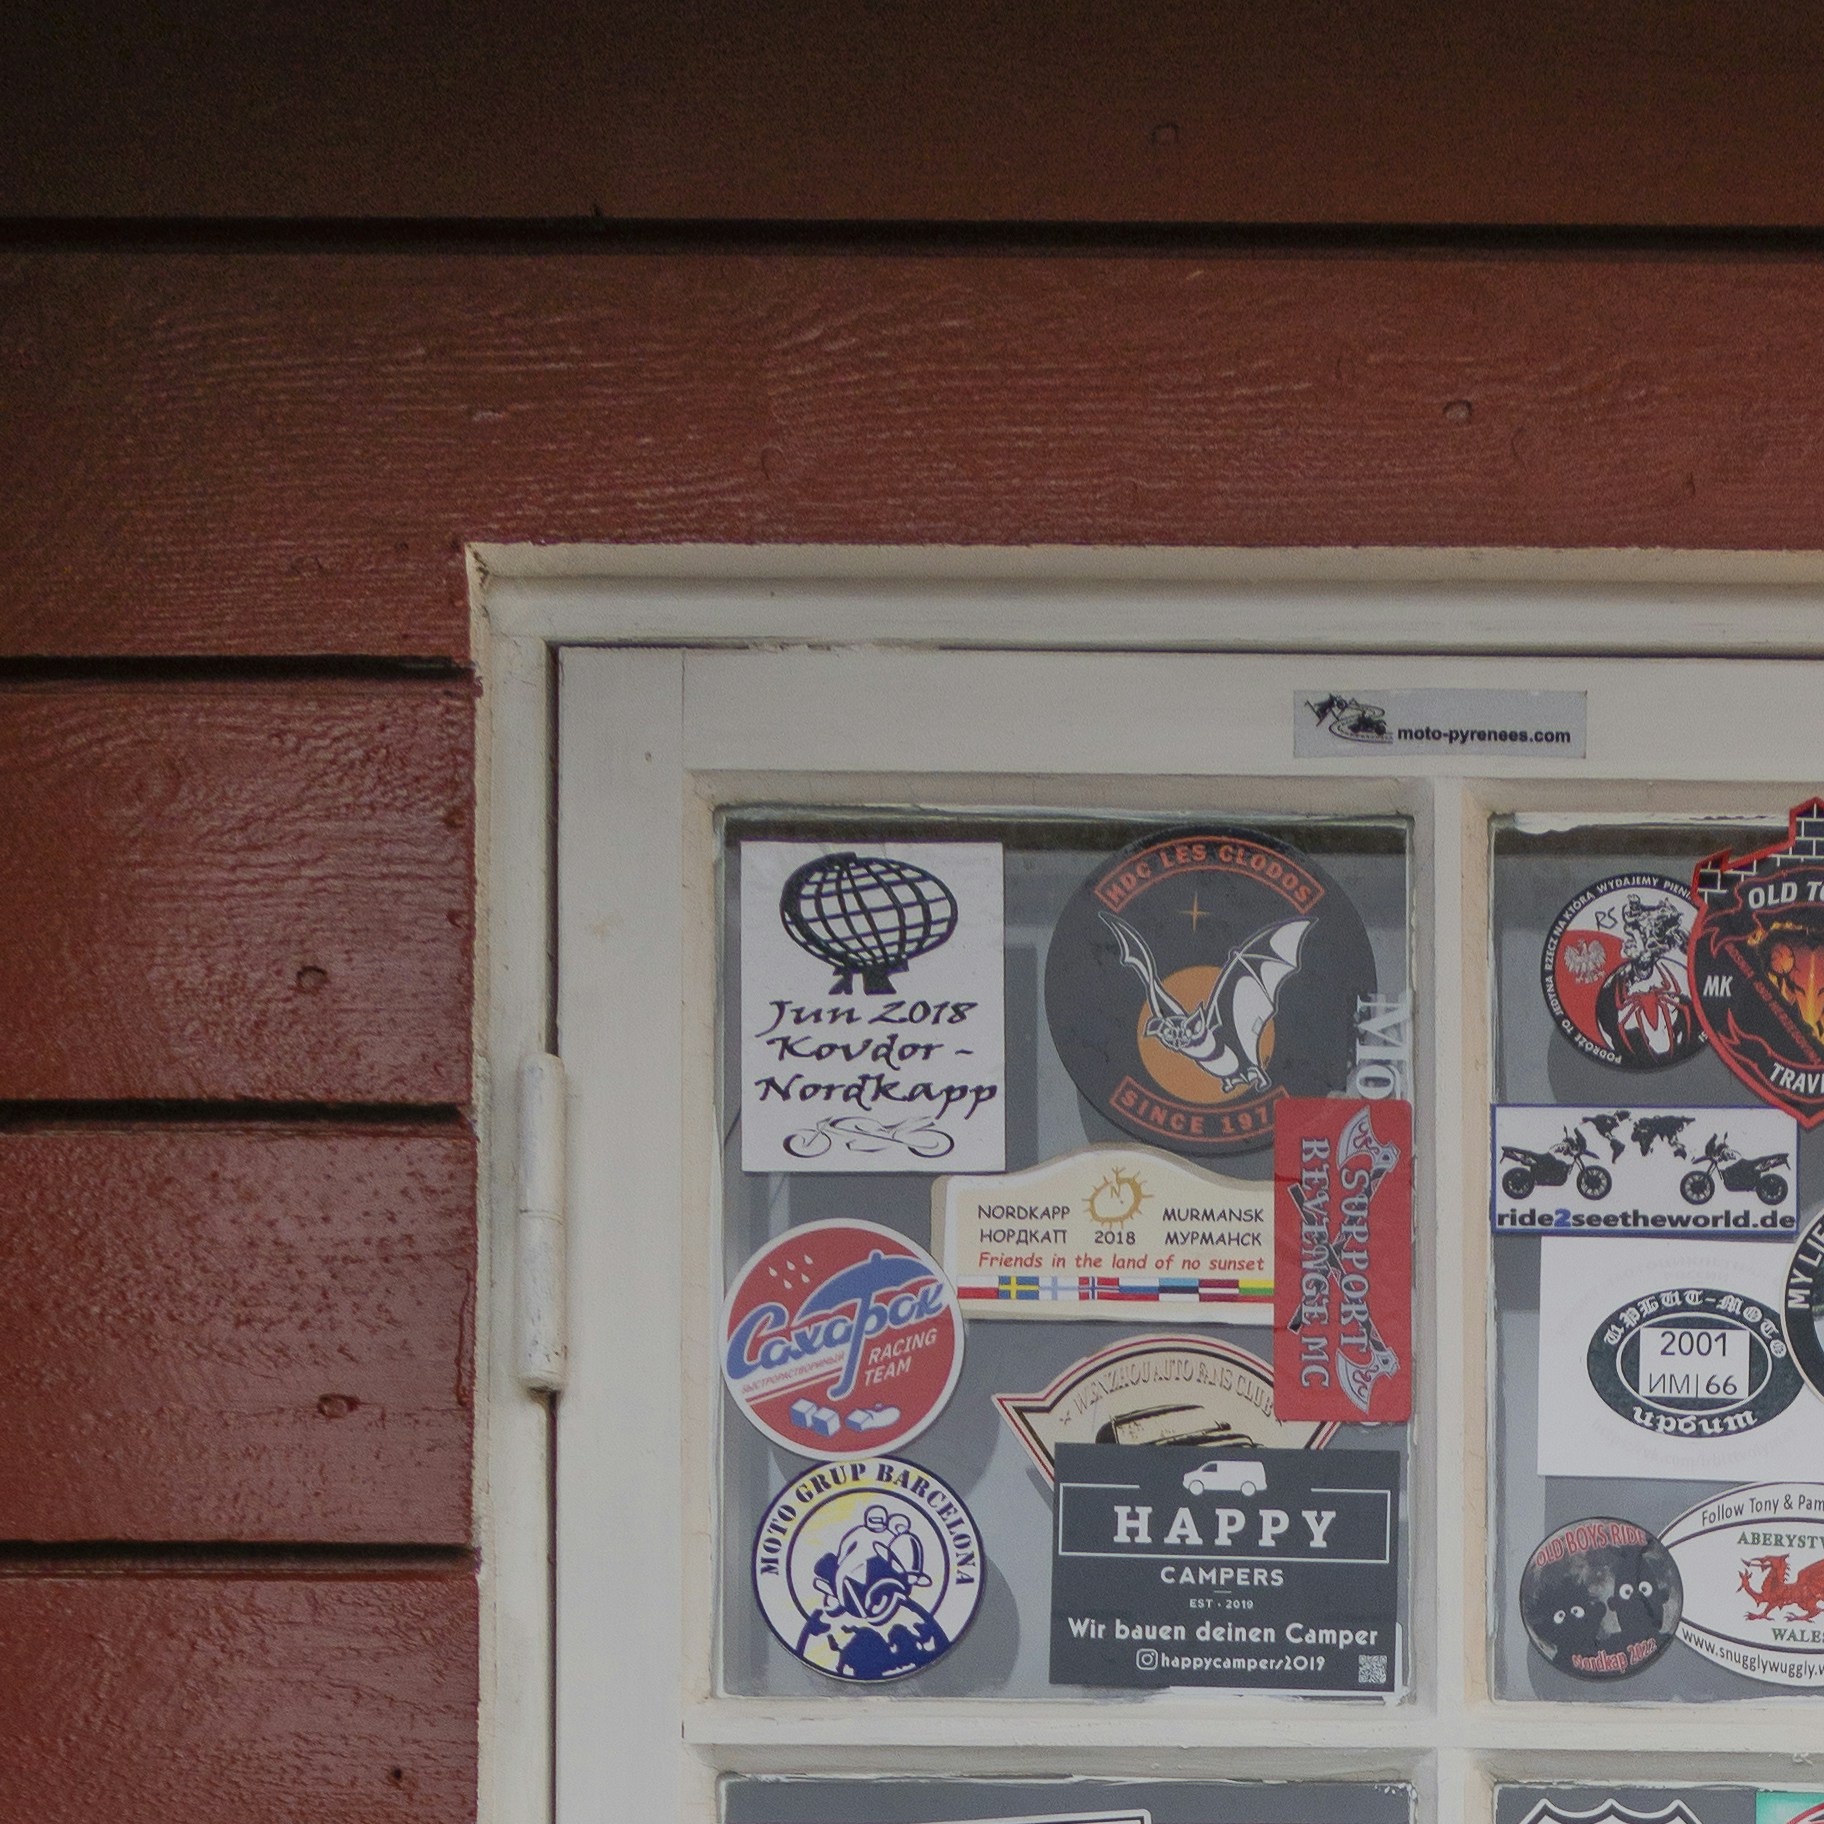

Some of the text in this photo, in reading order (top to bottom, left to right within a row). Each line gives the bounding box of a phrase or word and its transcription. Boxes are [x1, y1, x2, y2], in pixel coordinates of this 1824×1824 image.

[1398, 726, 1570, 744] moto-pyrenees.com
[1748, 881, 1799, 910] OLD
[756, 1000, 979, 1037] Jun 2018
[766, 1036, 942, 1070] Kovdor
[755, 1074, 998, 1118] Nordkapp
[978, 1205, 1264, 1223] NORDKAPP MURMANSK
[1497, 1208, 1796, 1229] ride2seetheworld.de
[980, 1229, 1068, 1245] НОРДКАП
[1094, 1230, 1136, 1245] 2018
[1165, 1230, 1262, 1247] МУРМАНСК
[979, 1252, 1264, 1271] Friends in the land of no sunset
[868, 1328, 938, 1362] RACING
[1660, 1331, 1729, 1357] 2001
[864, 1359, 912, 1387] TEAM
[1700, 1504, 1746, 1526] Follow
[1749, 1495, 1780, 1515] Tony
[1784, 1494, 1794, 1510] &
[1113, 1506, 1337, 1549] HAPPY
[1160, 1567, 1284, 1586] CAMPERS
[1069, 1618, 1378, 1646] Wir bauen deinen Camper
[1160, 1652, 1326, 1673] happycampers2019
